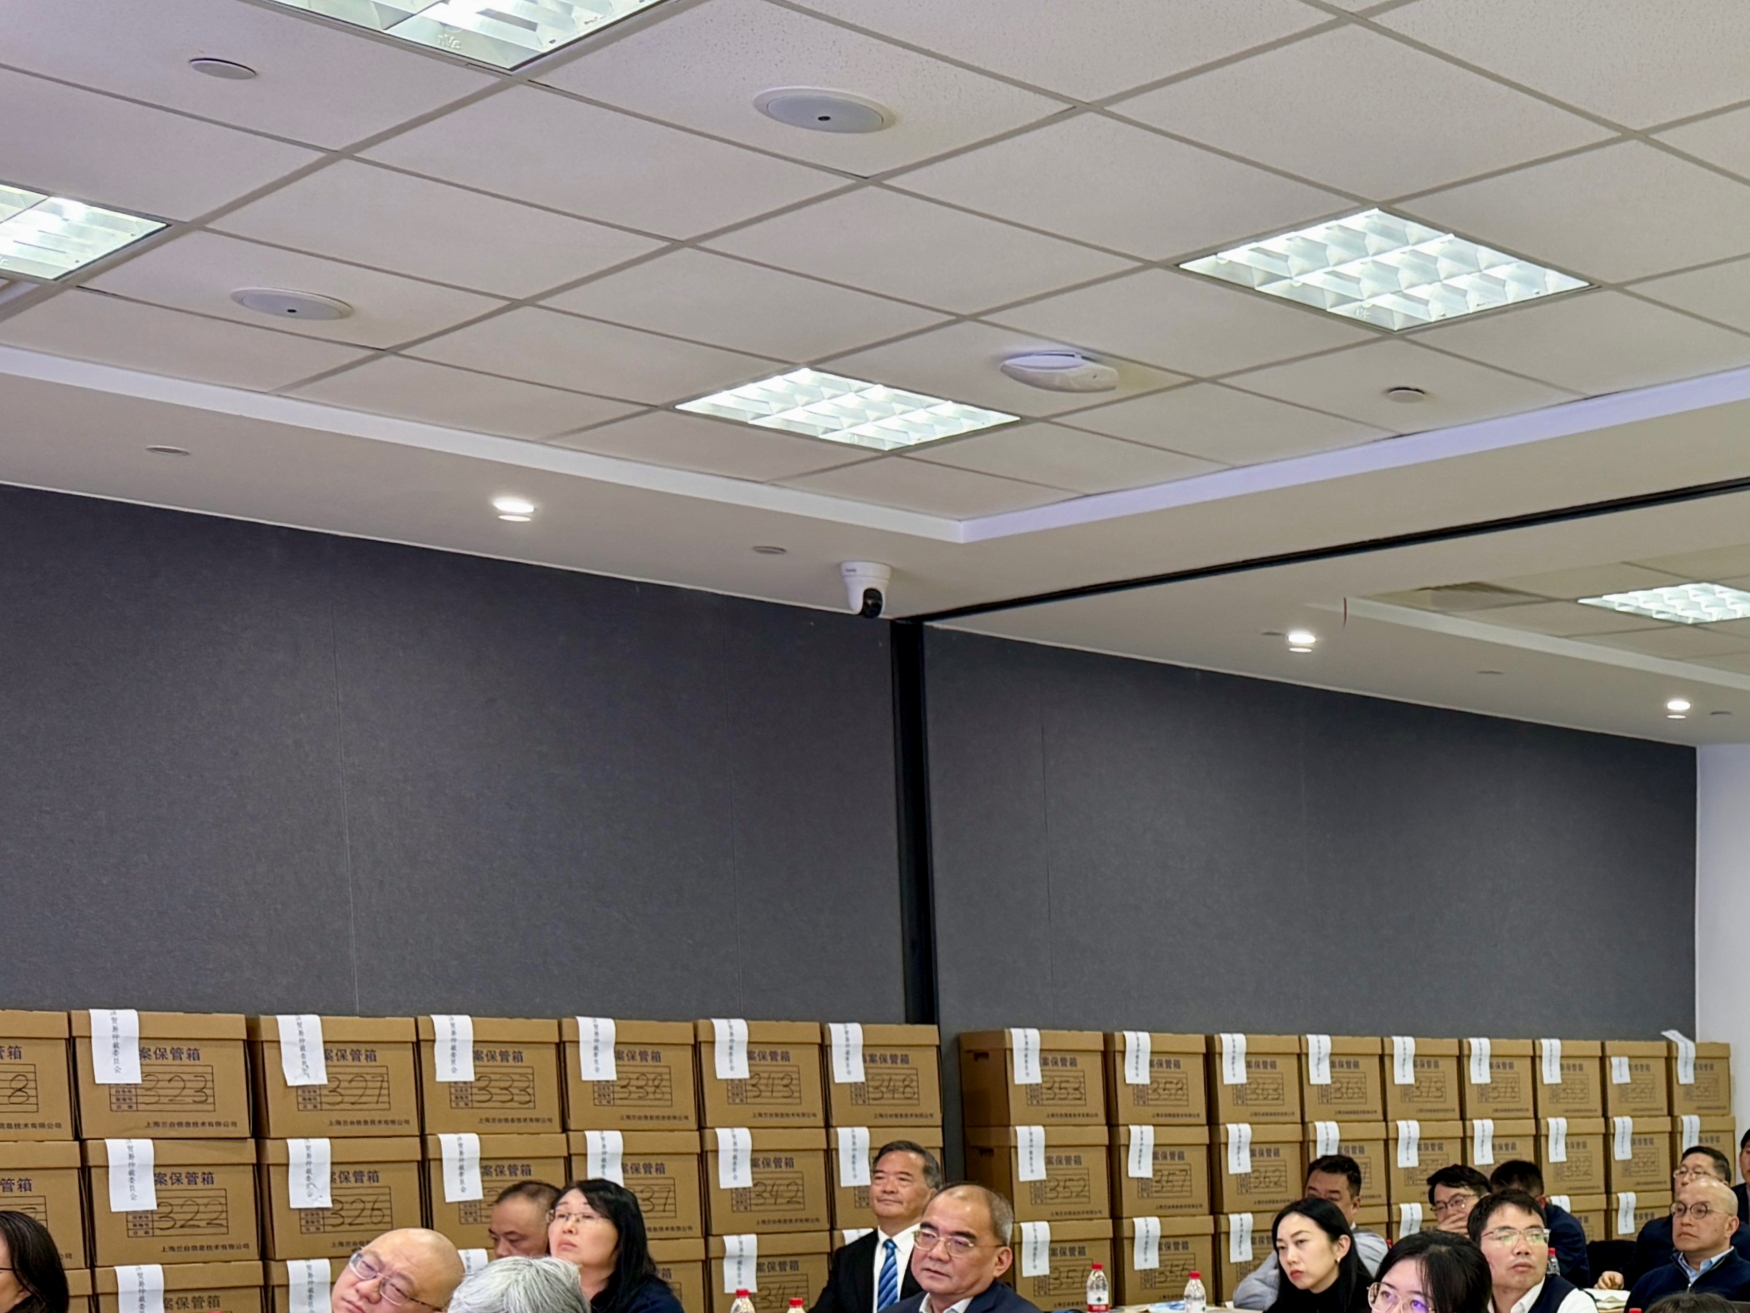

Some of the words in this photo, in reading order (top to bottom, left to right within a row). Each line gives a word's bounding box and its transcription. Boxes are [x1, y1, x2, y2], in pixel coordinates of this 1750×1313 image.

[142, 1074, 208, 1104] 323
[328, 1075, 385, 1106] 327
[473, 1074, 533, 1105] 333
[619, 1073, 665, 1100] 338
[750, 1073, 795, 1099] 343
[871, 1075, 917, 1100] 348
[1045, 1078, 1084, 1101] 353
[1151, 1080, 1186, 1101] 358
[1247, 1080, 1282, 1101] 363
[1047, 1177, 1088, 1200] 352
[1154, 1169, 1189, 1193] 357
[1252, 1168, 1283, 1188] 362
[755, 1183, 802, 1206] 342
[157, 1199, 226, 1231] 322
[330, 1197, 385, 1228] 326
